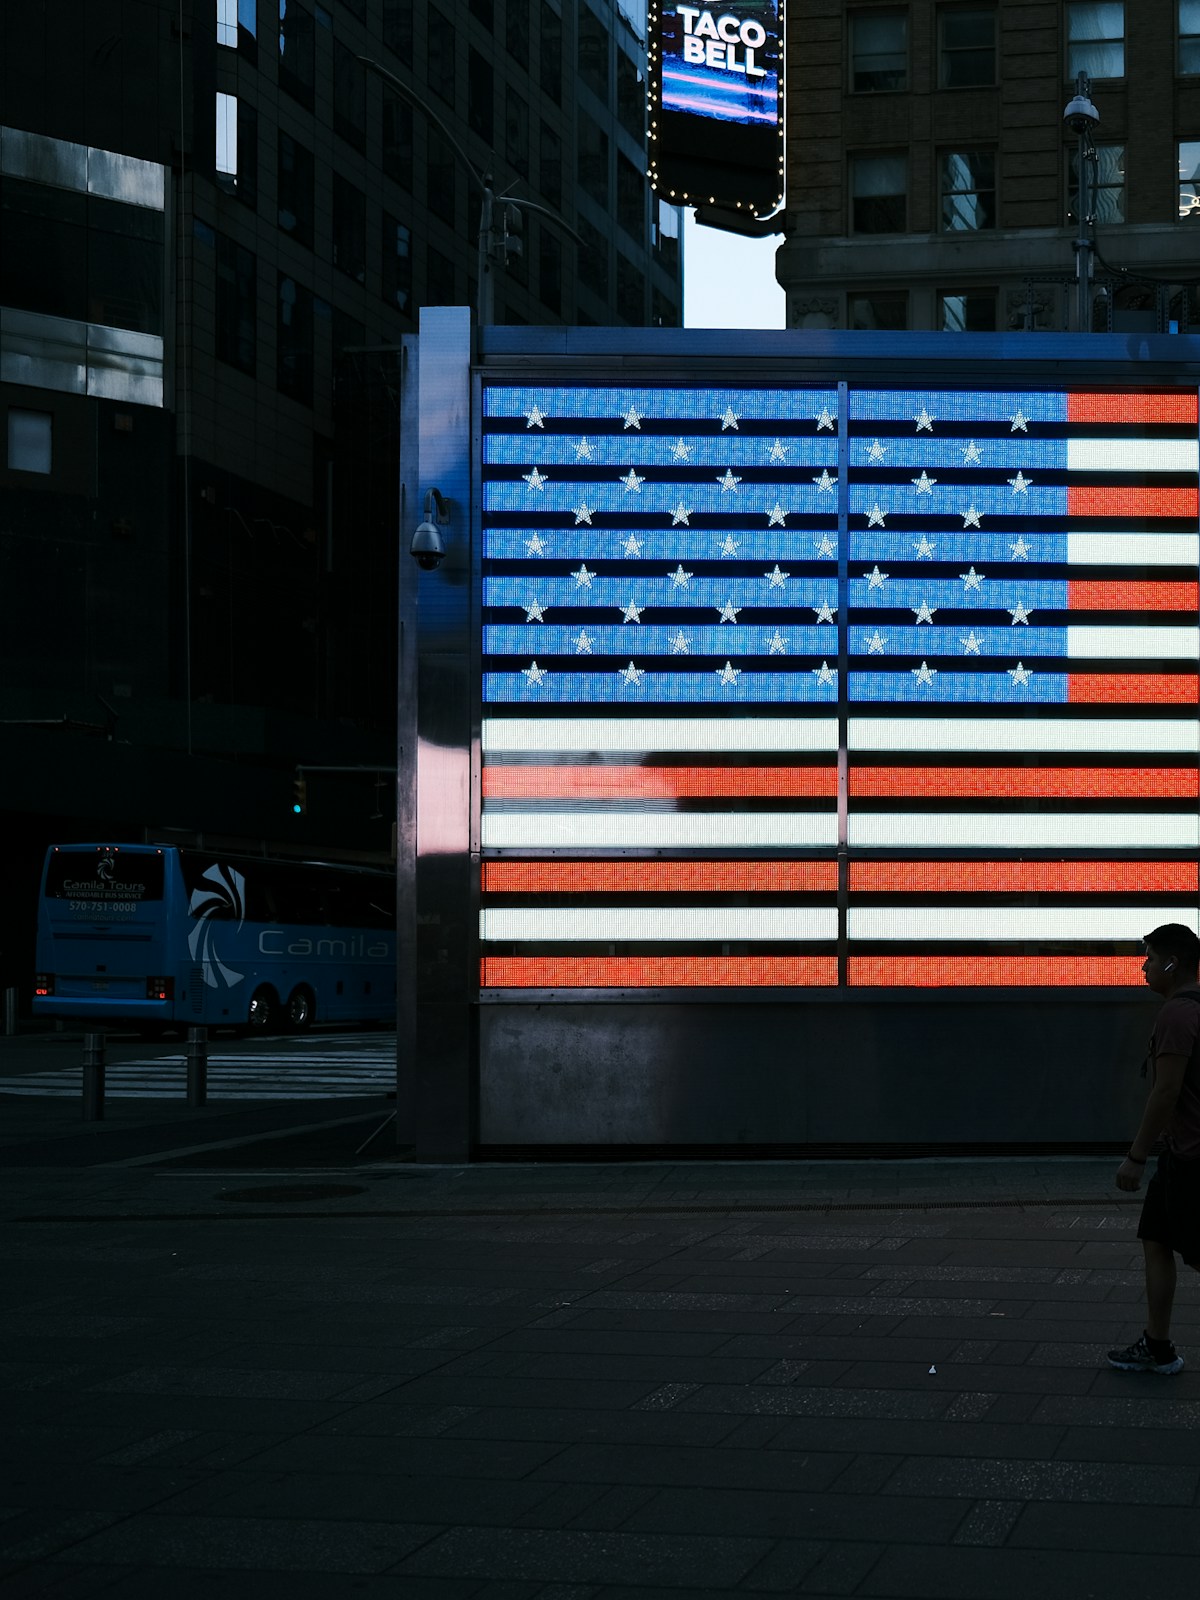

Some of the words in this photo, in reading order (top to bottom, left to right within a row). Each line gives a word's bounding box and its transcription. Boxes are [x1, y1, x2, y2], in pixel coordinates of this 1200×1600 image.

[677, 4, 767, 48] TACO
[683, 34, 768, 77] BELL
[63, 879, 105, 890] Camila
[109, 880, 146, 892] Tours
[69, 901, 136, 912] 570-751-0008
[258, 930, 389, 958] Camila
